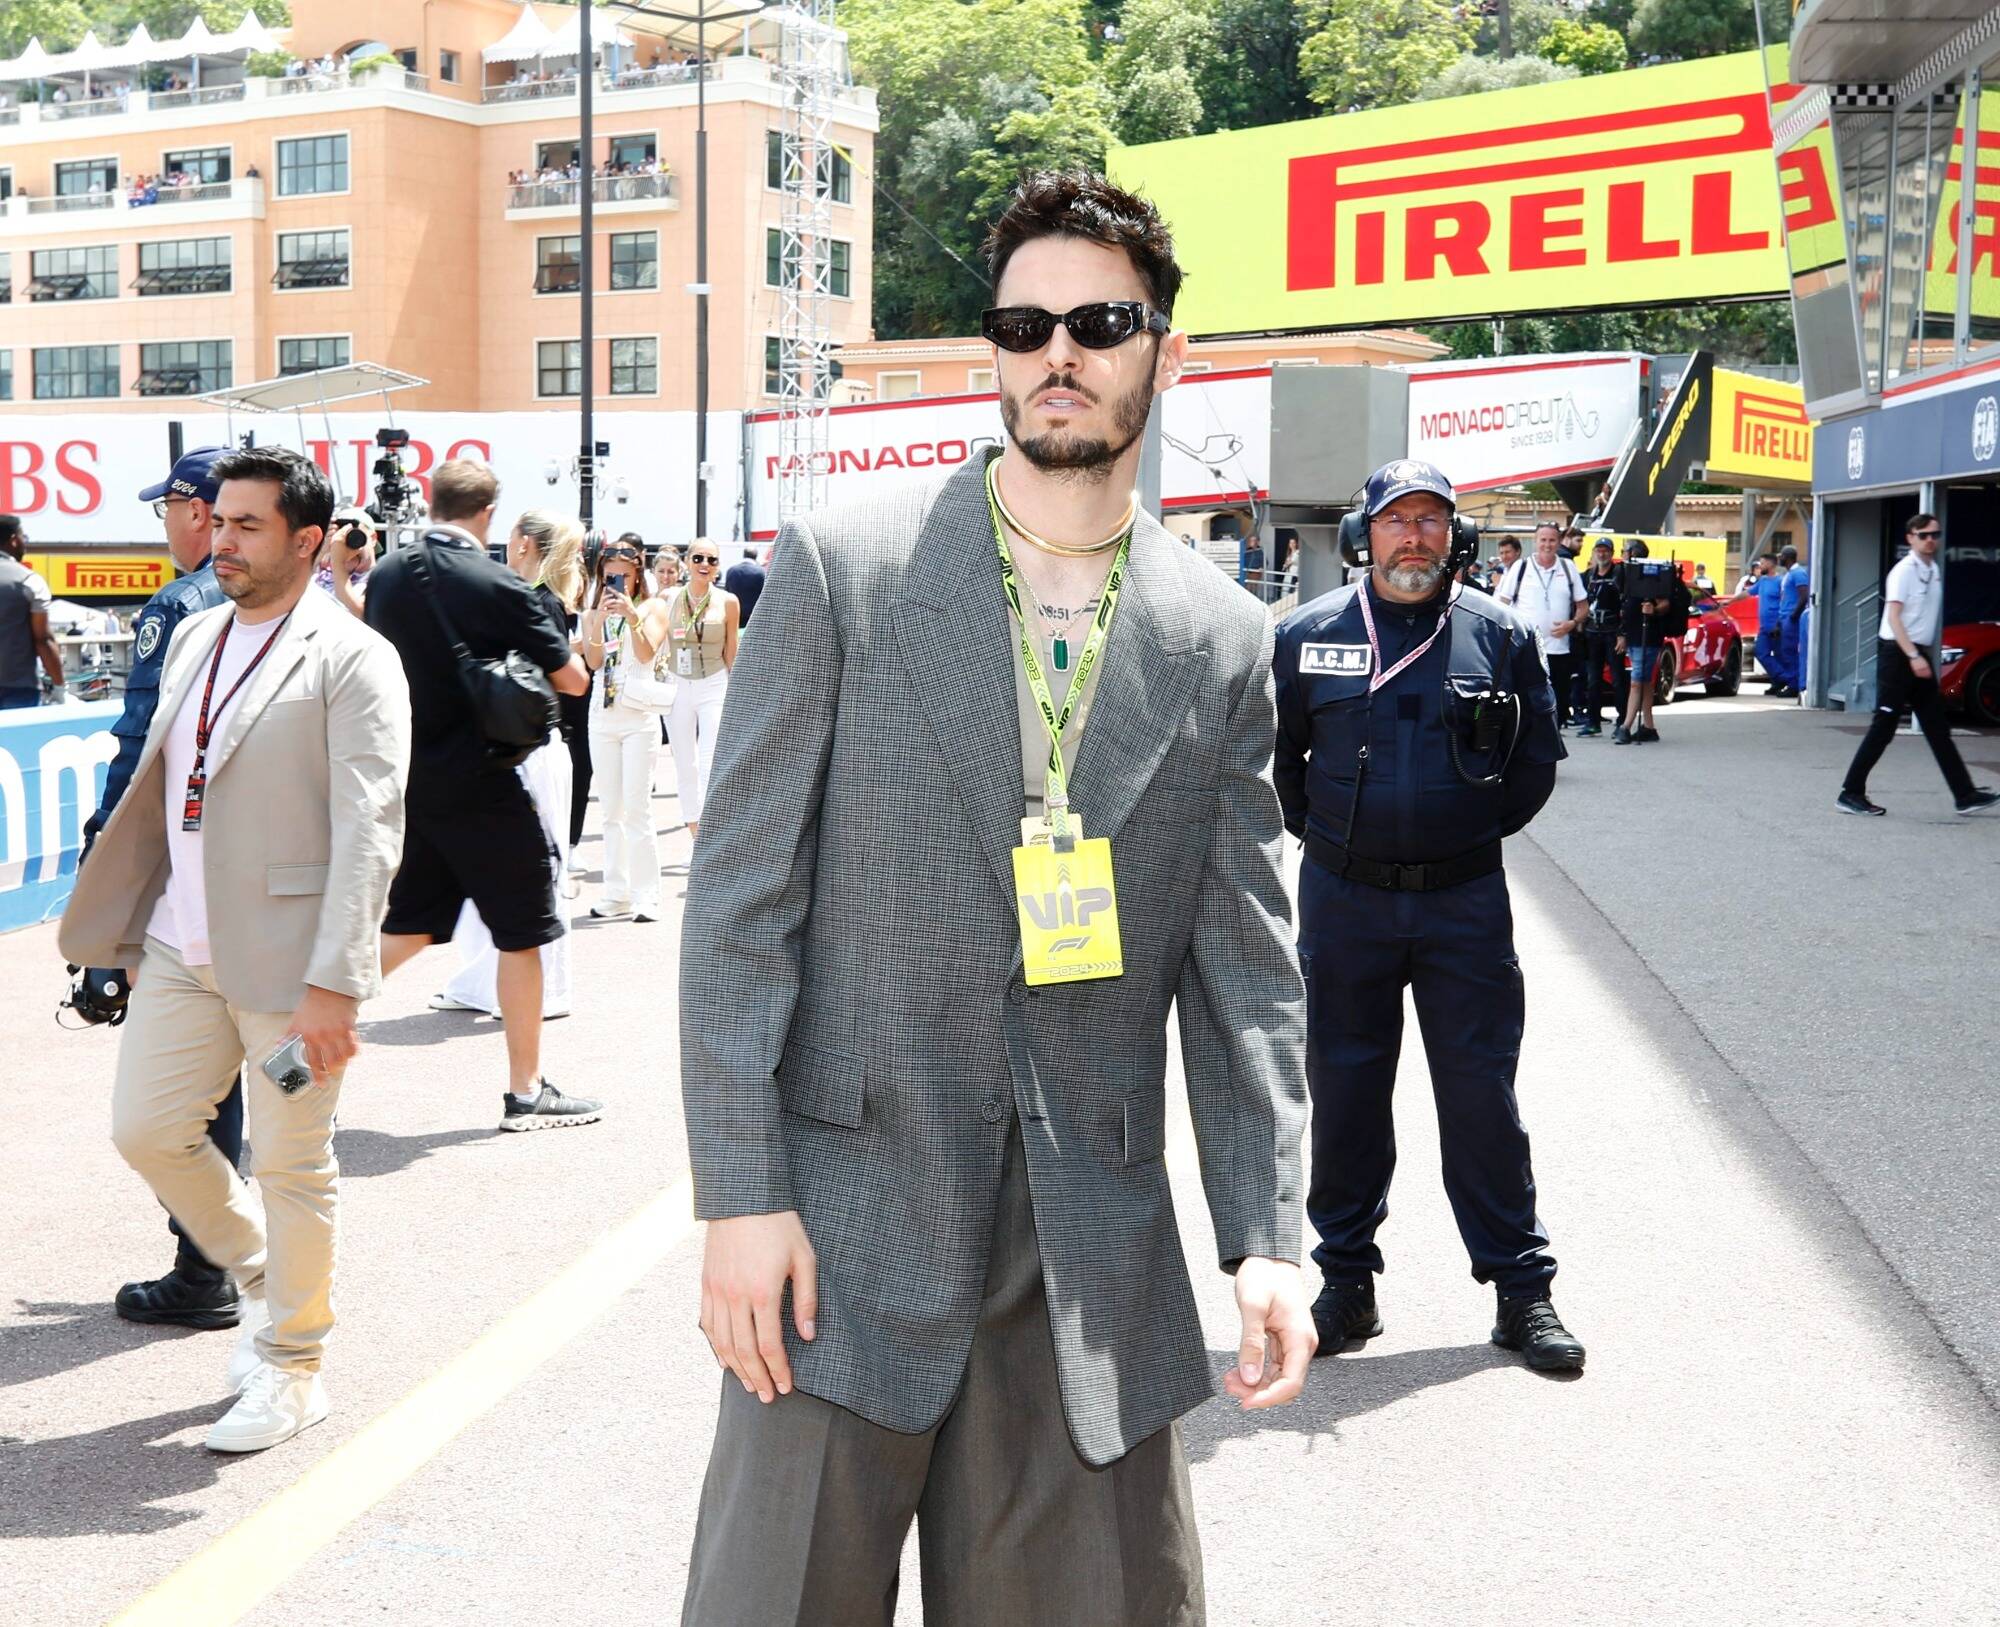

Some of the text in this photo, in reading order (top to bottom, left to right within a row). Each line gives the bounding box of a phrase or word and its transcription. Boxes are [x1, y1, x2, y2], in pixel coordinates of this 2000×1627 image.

[1286, 92, 1786, 292] PIRELL
[1661, 378, 1699, 469] ZERO
[1733, 391, 1809, 463] PIRELLI
[1511, 433, 1534, 448] SINCE
[171, 479, 198, 495] 2024
[66, 562, 162, 588] PIRELLI
[1072, 649, 1095, 690] 2024
[1306, 649, 1366, 669] A.C.M.
[1020, 887, 1113, 930] VIP
[1049, 964, 1089, 978] 2024
